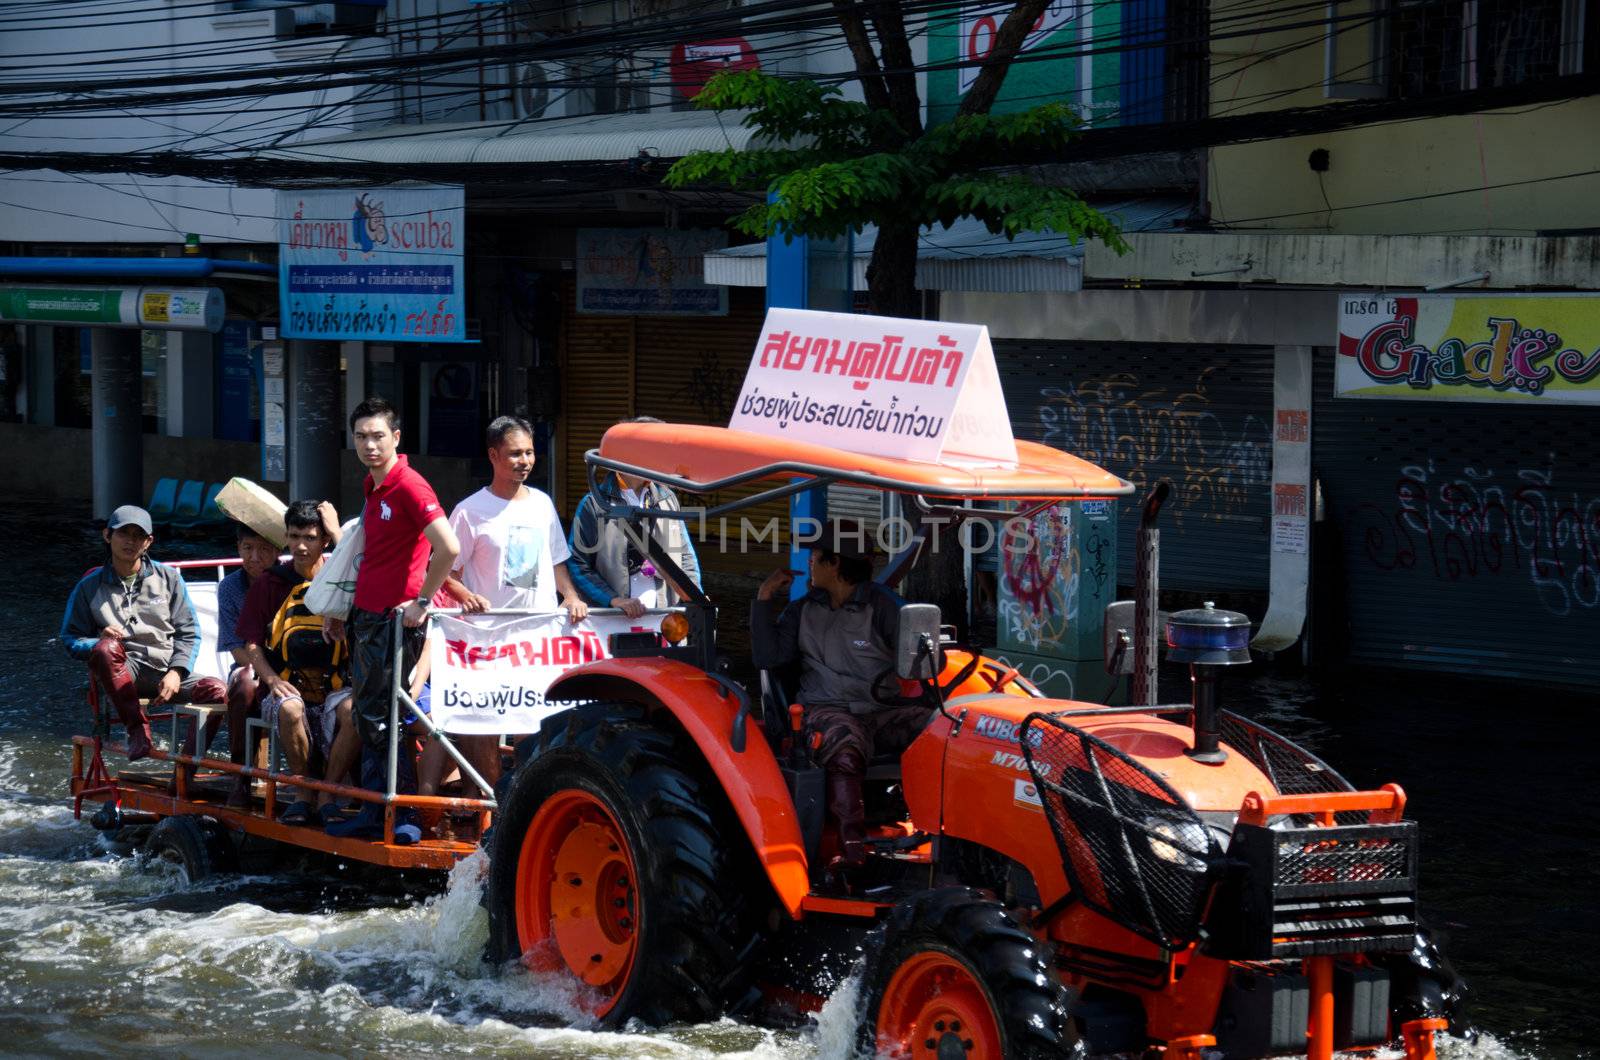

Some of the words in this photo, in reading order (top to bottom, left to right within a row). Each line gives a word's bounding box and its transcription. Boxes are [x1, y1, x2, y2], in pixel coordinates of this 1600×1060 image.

[391, 209, 454, 249] scuba
[760, 331, 964, 390] สยามคูโบต้า
[1357, 316, 1557, 394] Grade
[741, 388, 943, 438] ช่วยผู้ประสบภัยน้ำท่วม
